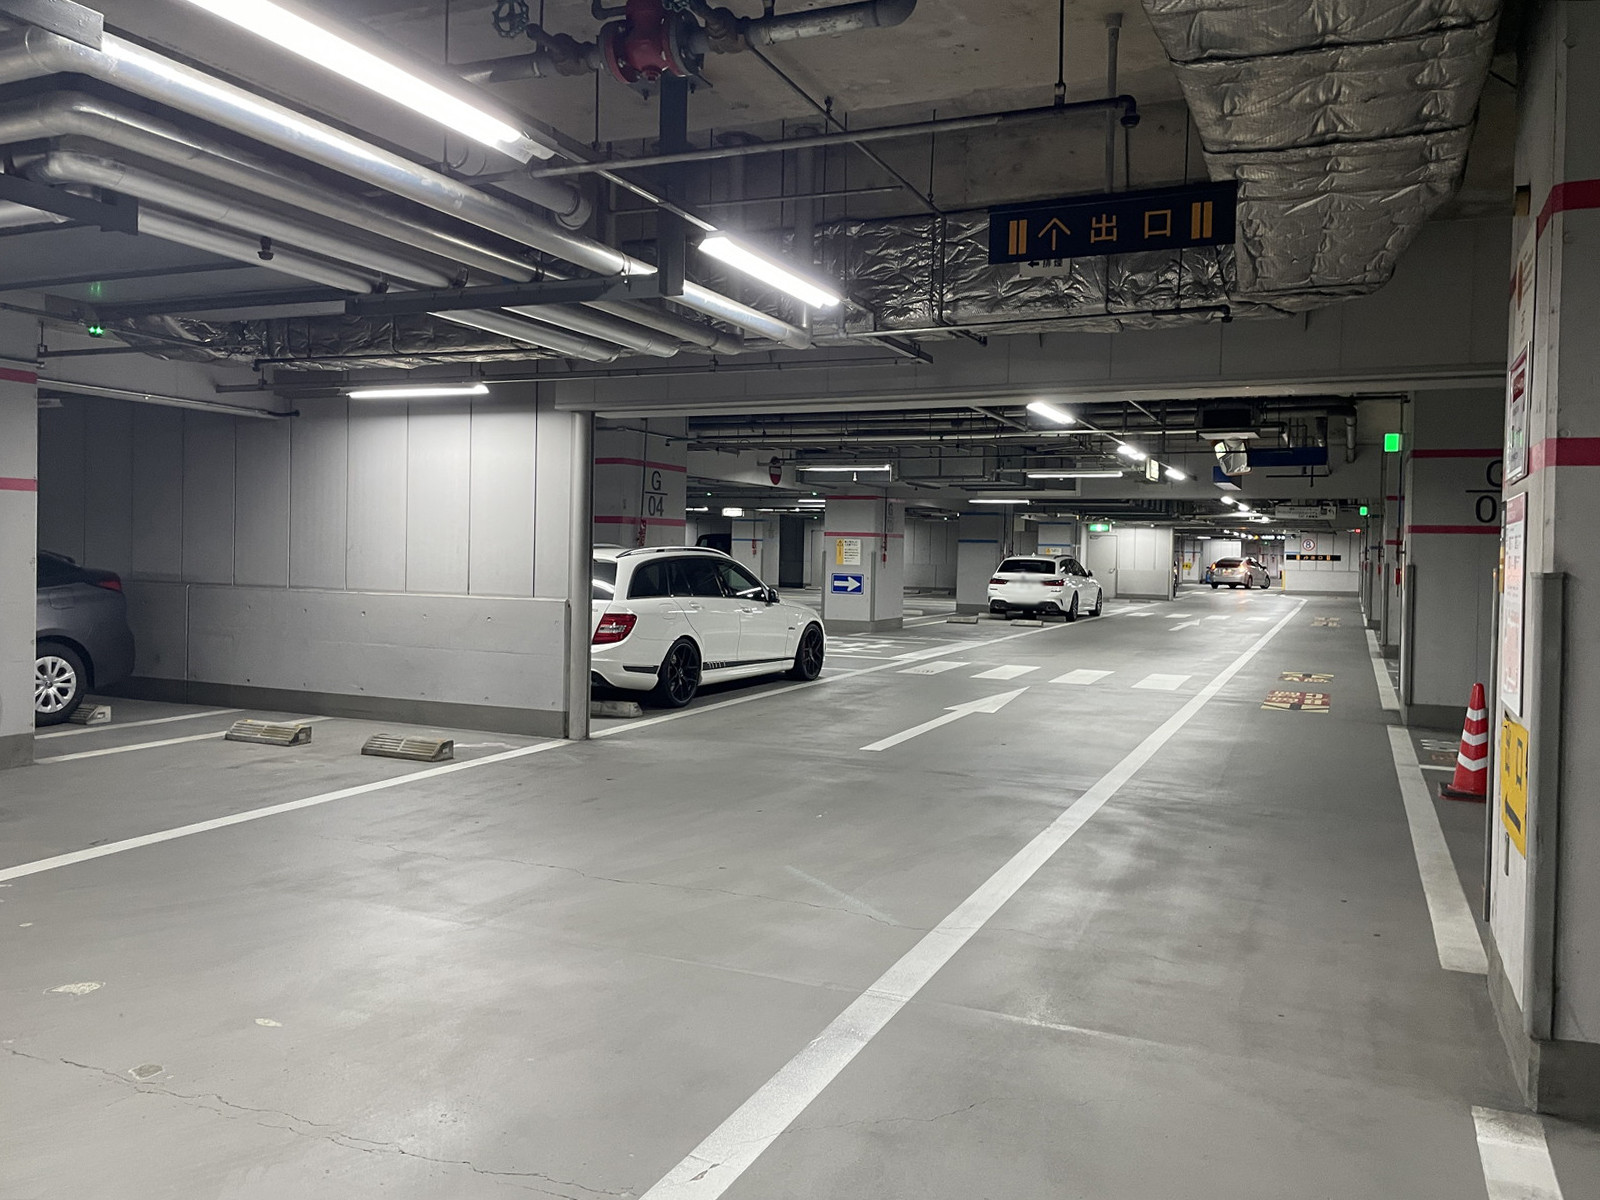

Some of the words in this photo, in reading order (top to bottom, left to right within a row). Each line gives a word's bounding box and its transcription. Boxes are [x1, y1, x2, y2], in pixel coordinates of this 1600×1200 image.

[1090, 209, 1172, 243] 出口
[651, 470, 661, 491] G
[648, 495, 665, 517] 04
